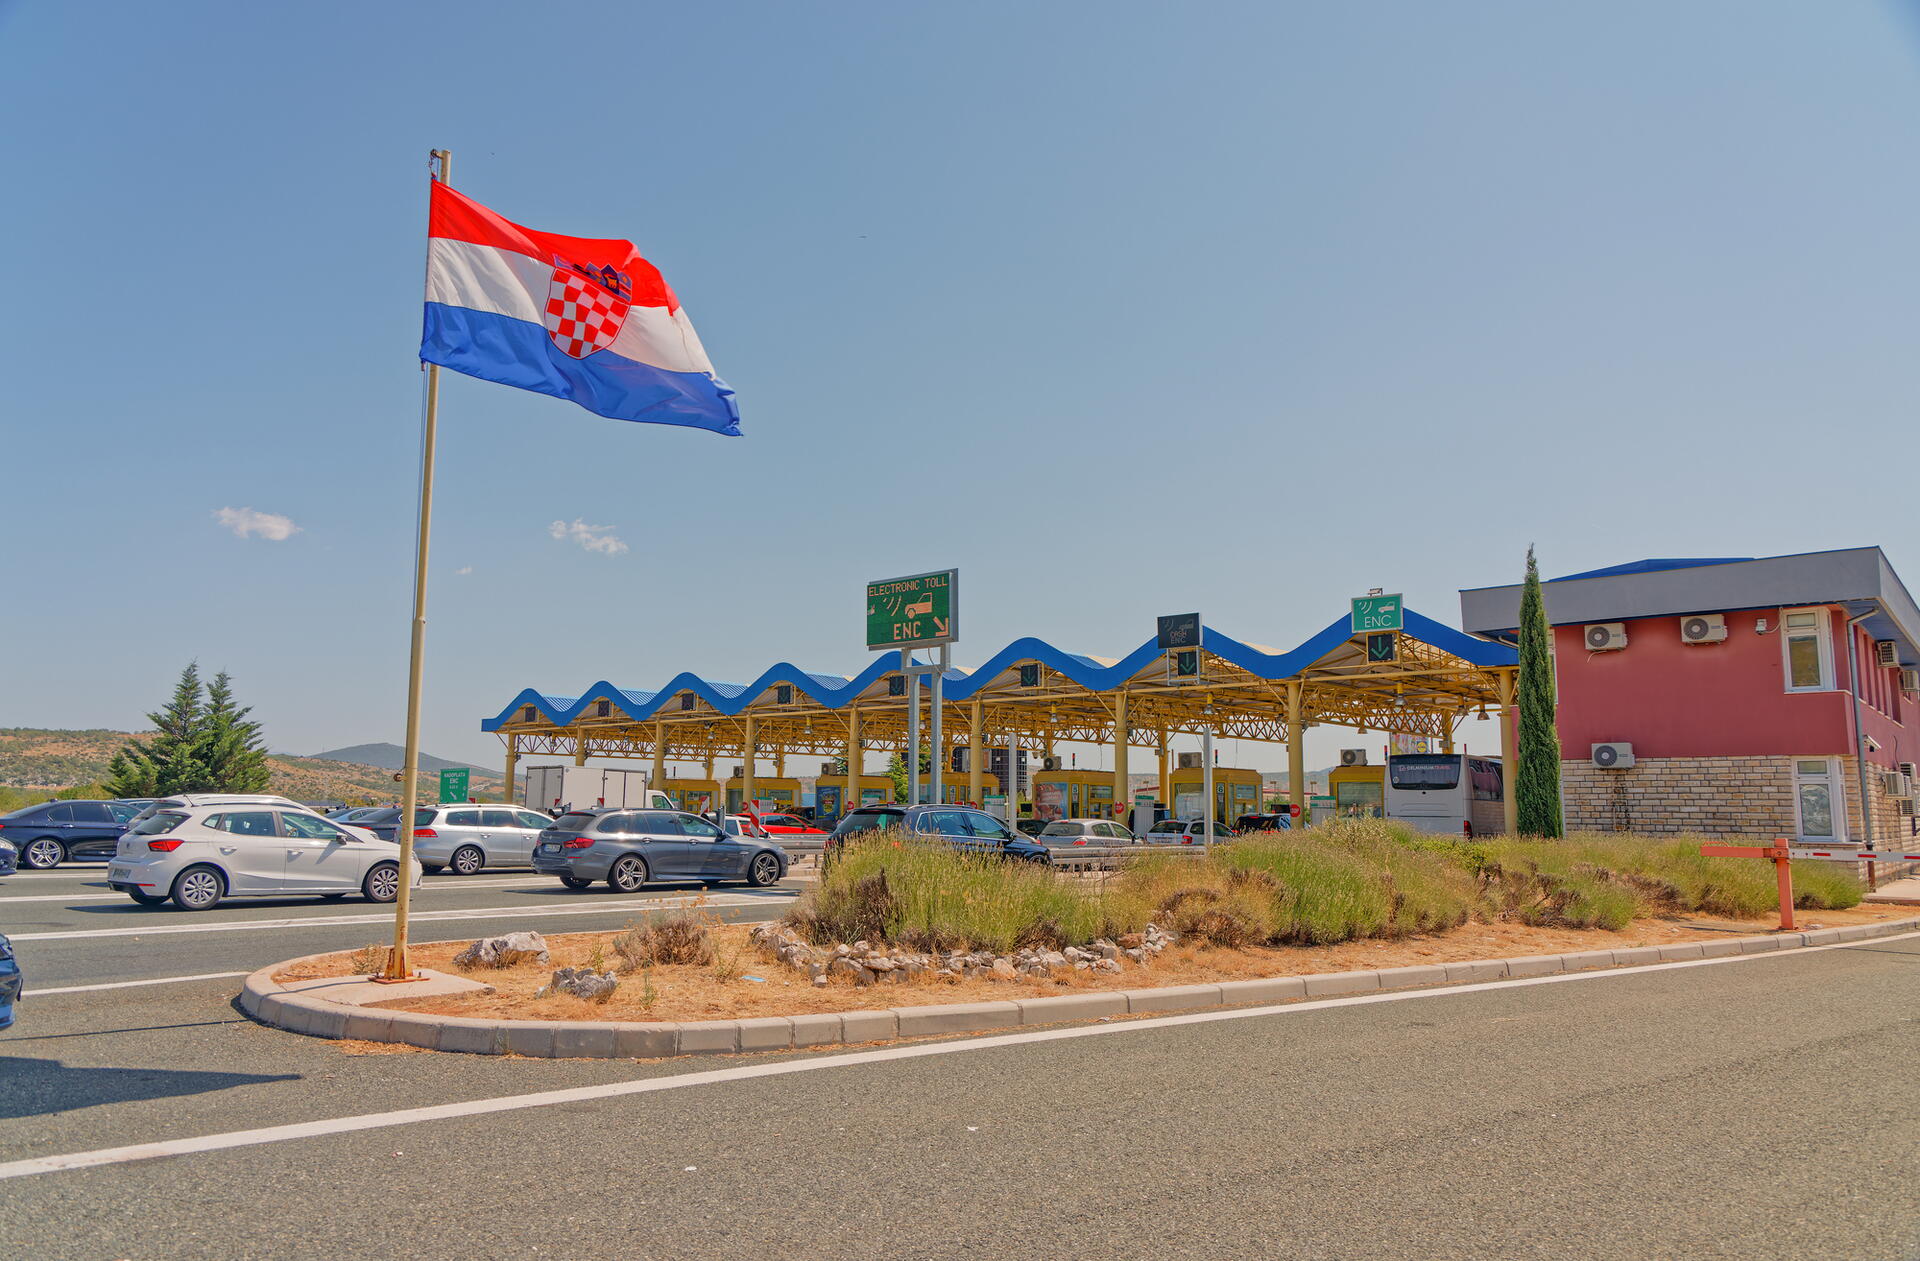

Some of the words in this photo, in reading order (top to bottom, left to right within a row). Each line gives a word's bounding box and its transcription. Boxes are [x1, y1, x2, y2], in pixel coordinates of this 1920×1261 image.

[868, 580, 920, 597] ELECTRONIC
[924, 576, 948, 588] TOLL
[893, 621, 921, 640] ENC
[1364, 614, 1392, 628] ENC
